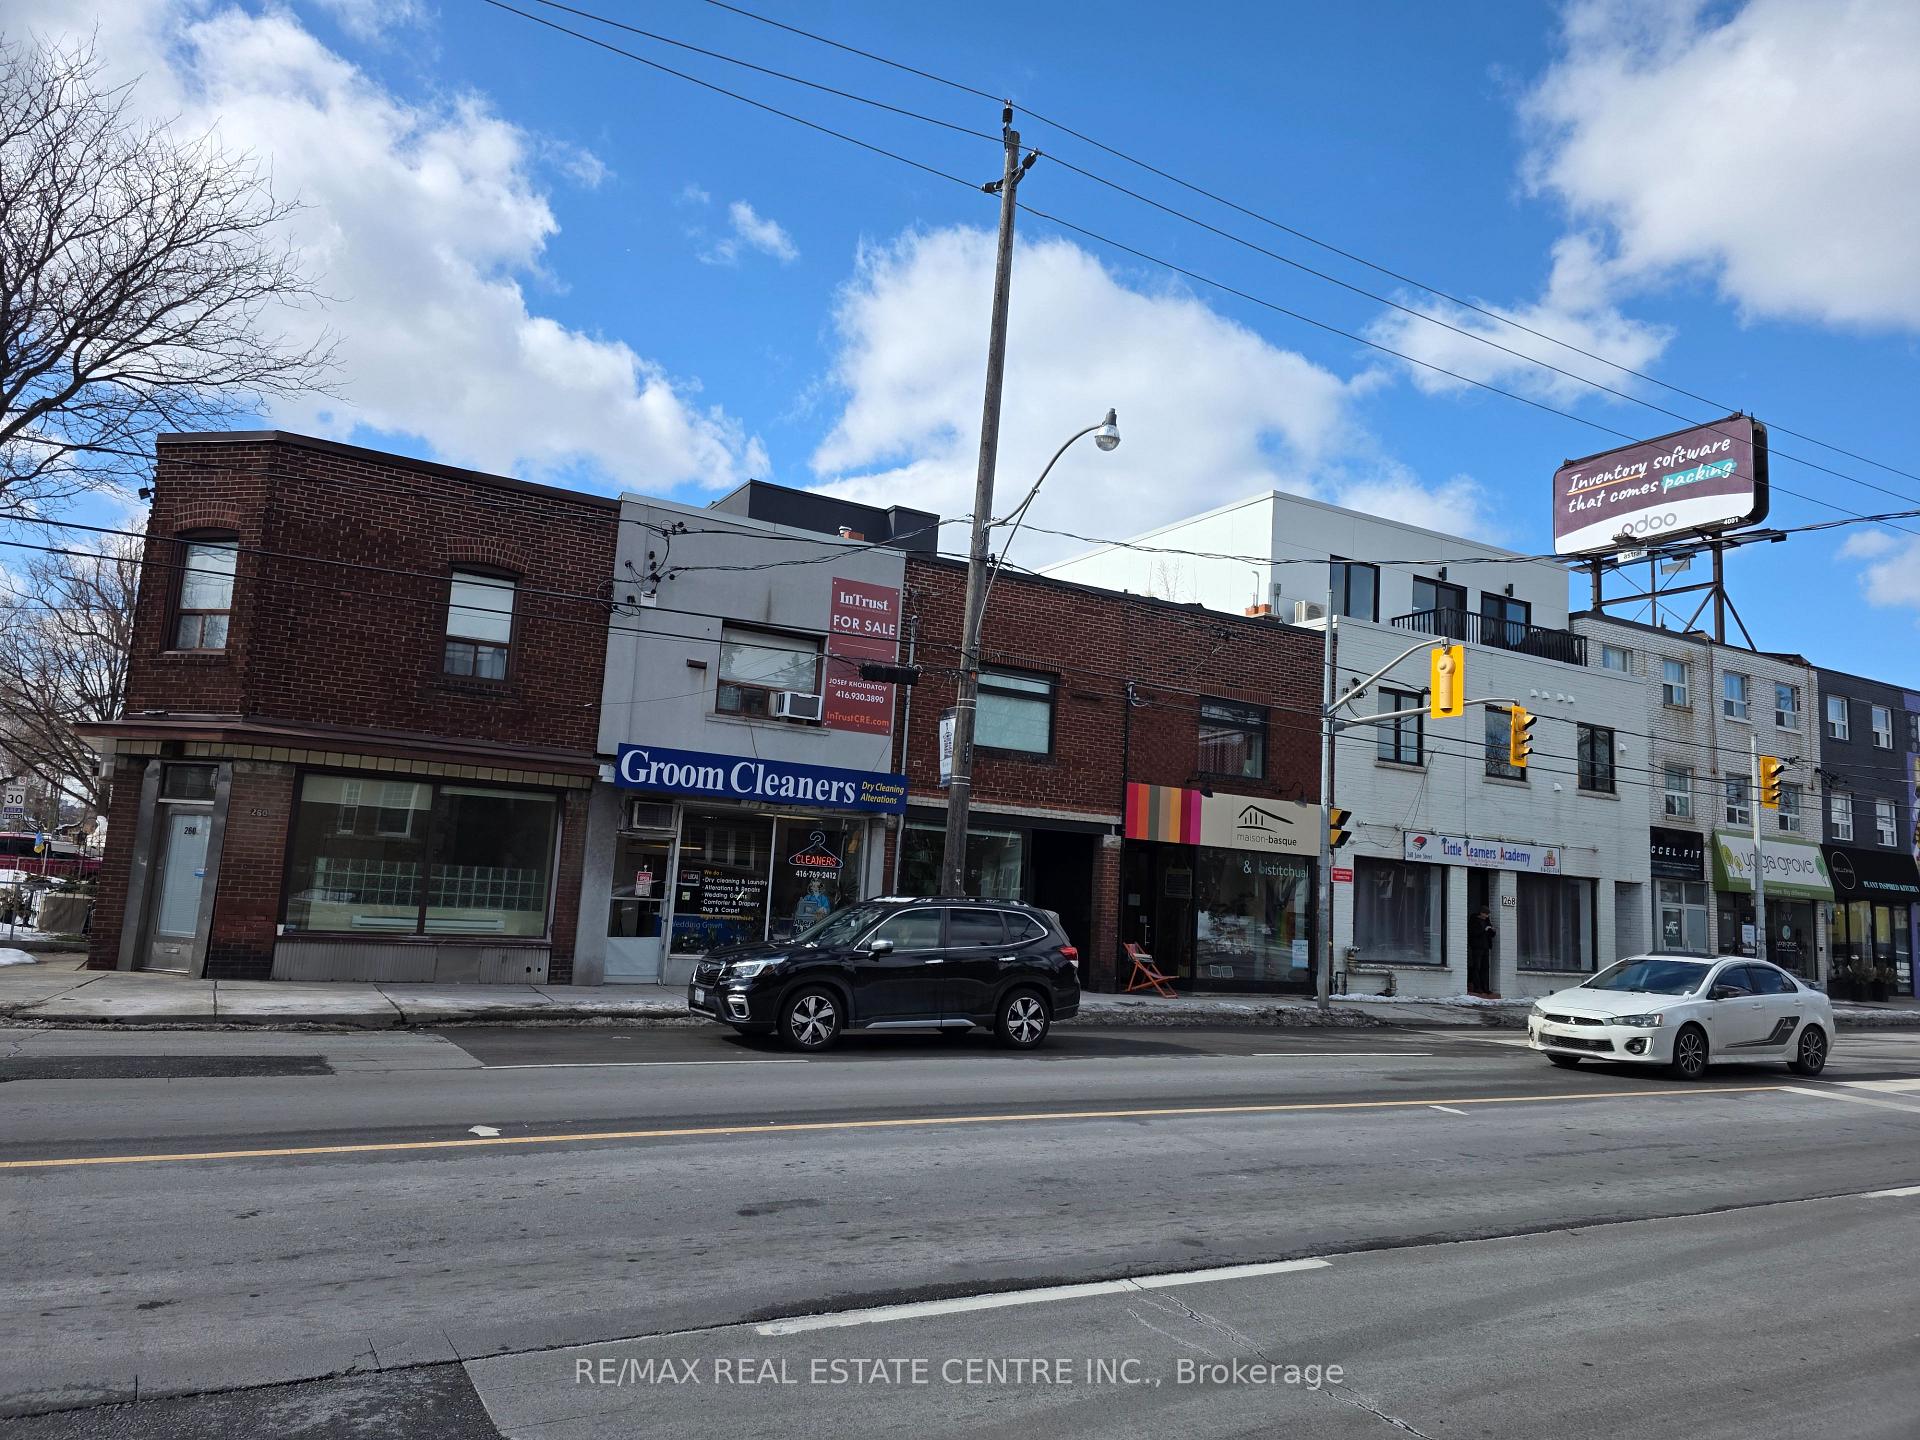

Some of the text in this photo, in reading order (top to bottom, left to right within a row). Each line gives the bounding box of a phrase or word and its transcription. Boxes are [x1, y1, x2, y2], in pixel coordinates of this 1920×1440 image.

[1568, 438, 1731, 493] Inventory software
[1568, 462, 1733, 513] that comes packing
[1622, 512, 1677, 534] odoo
[840, 591, 889, 611] InTrust
[833, 614, 860, 630] FOR
[864, 619, 896, 636] SALE
[829, 678, 848, 686] JOSEF
[835, 690, 885, 704] 416.930.3890
[826, 711, 889, 727] InTrustCRE.com
[620, 749, 856, 805] Groom Cleaners
[861, 781, 905, 796] Dry Cleaning
[6, 794, 23, 804] 30
[860, 792, 898, 805] Alterations
[251, 808, 268, 817] 260
[184, 827, 197, 835] 260
[1236, 832, 1297, 847] maison-basque
[1441, 840, 1531, 867] Little Learners Academy
[1651, 845, 1701, 859] CCEL.FIT
[795, 854, 837, 867] CLEANERS
[1243, 860, 1252, 874] &
[1777, 856, 1815, 876] grove
[795, 870, 837, 880] 416-769-2412
[704, 892, 728, 900] Wedding
[1503, 896, 1516, 905] 268
[738, 900, 760, 908] Drapery
